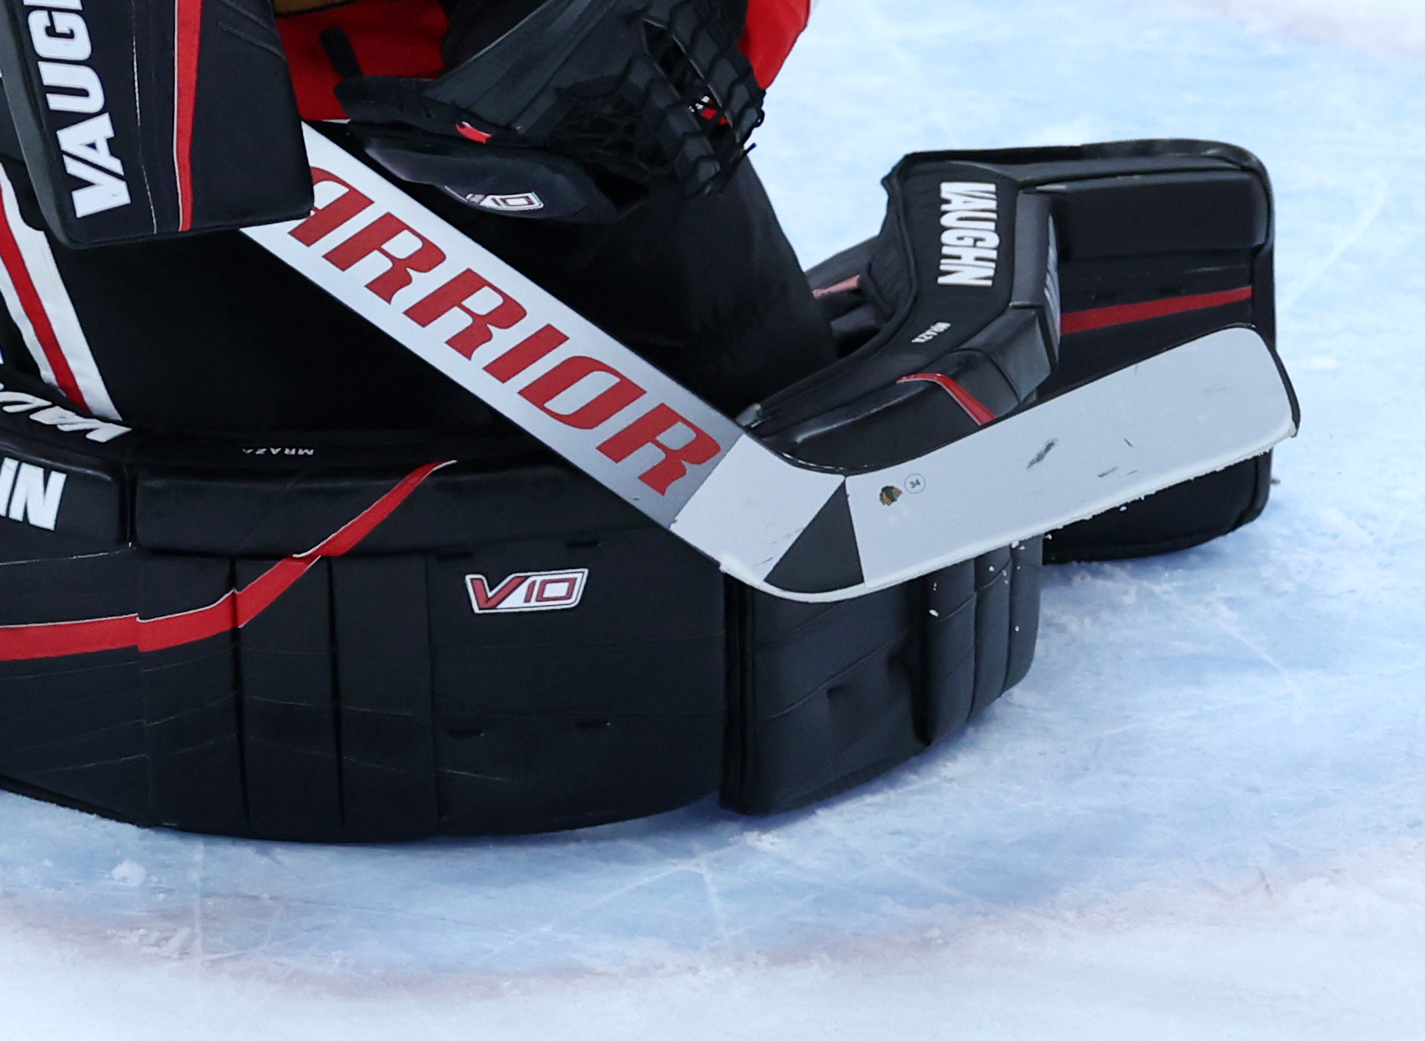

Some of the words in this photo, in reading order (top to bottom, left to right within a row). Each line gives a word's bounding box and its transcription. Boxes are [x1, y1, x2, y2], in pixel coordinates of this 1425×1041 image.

[936, 181, 1001, 287] VAUGHN
[287, 166, 722, 497] ARRIOR
[467, 569, 588, 612] V10
